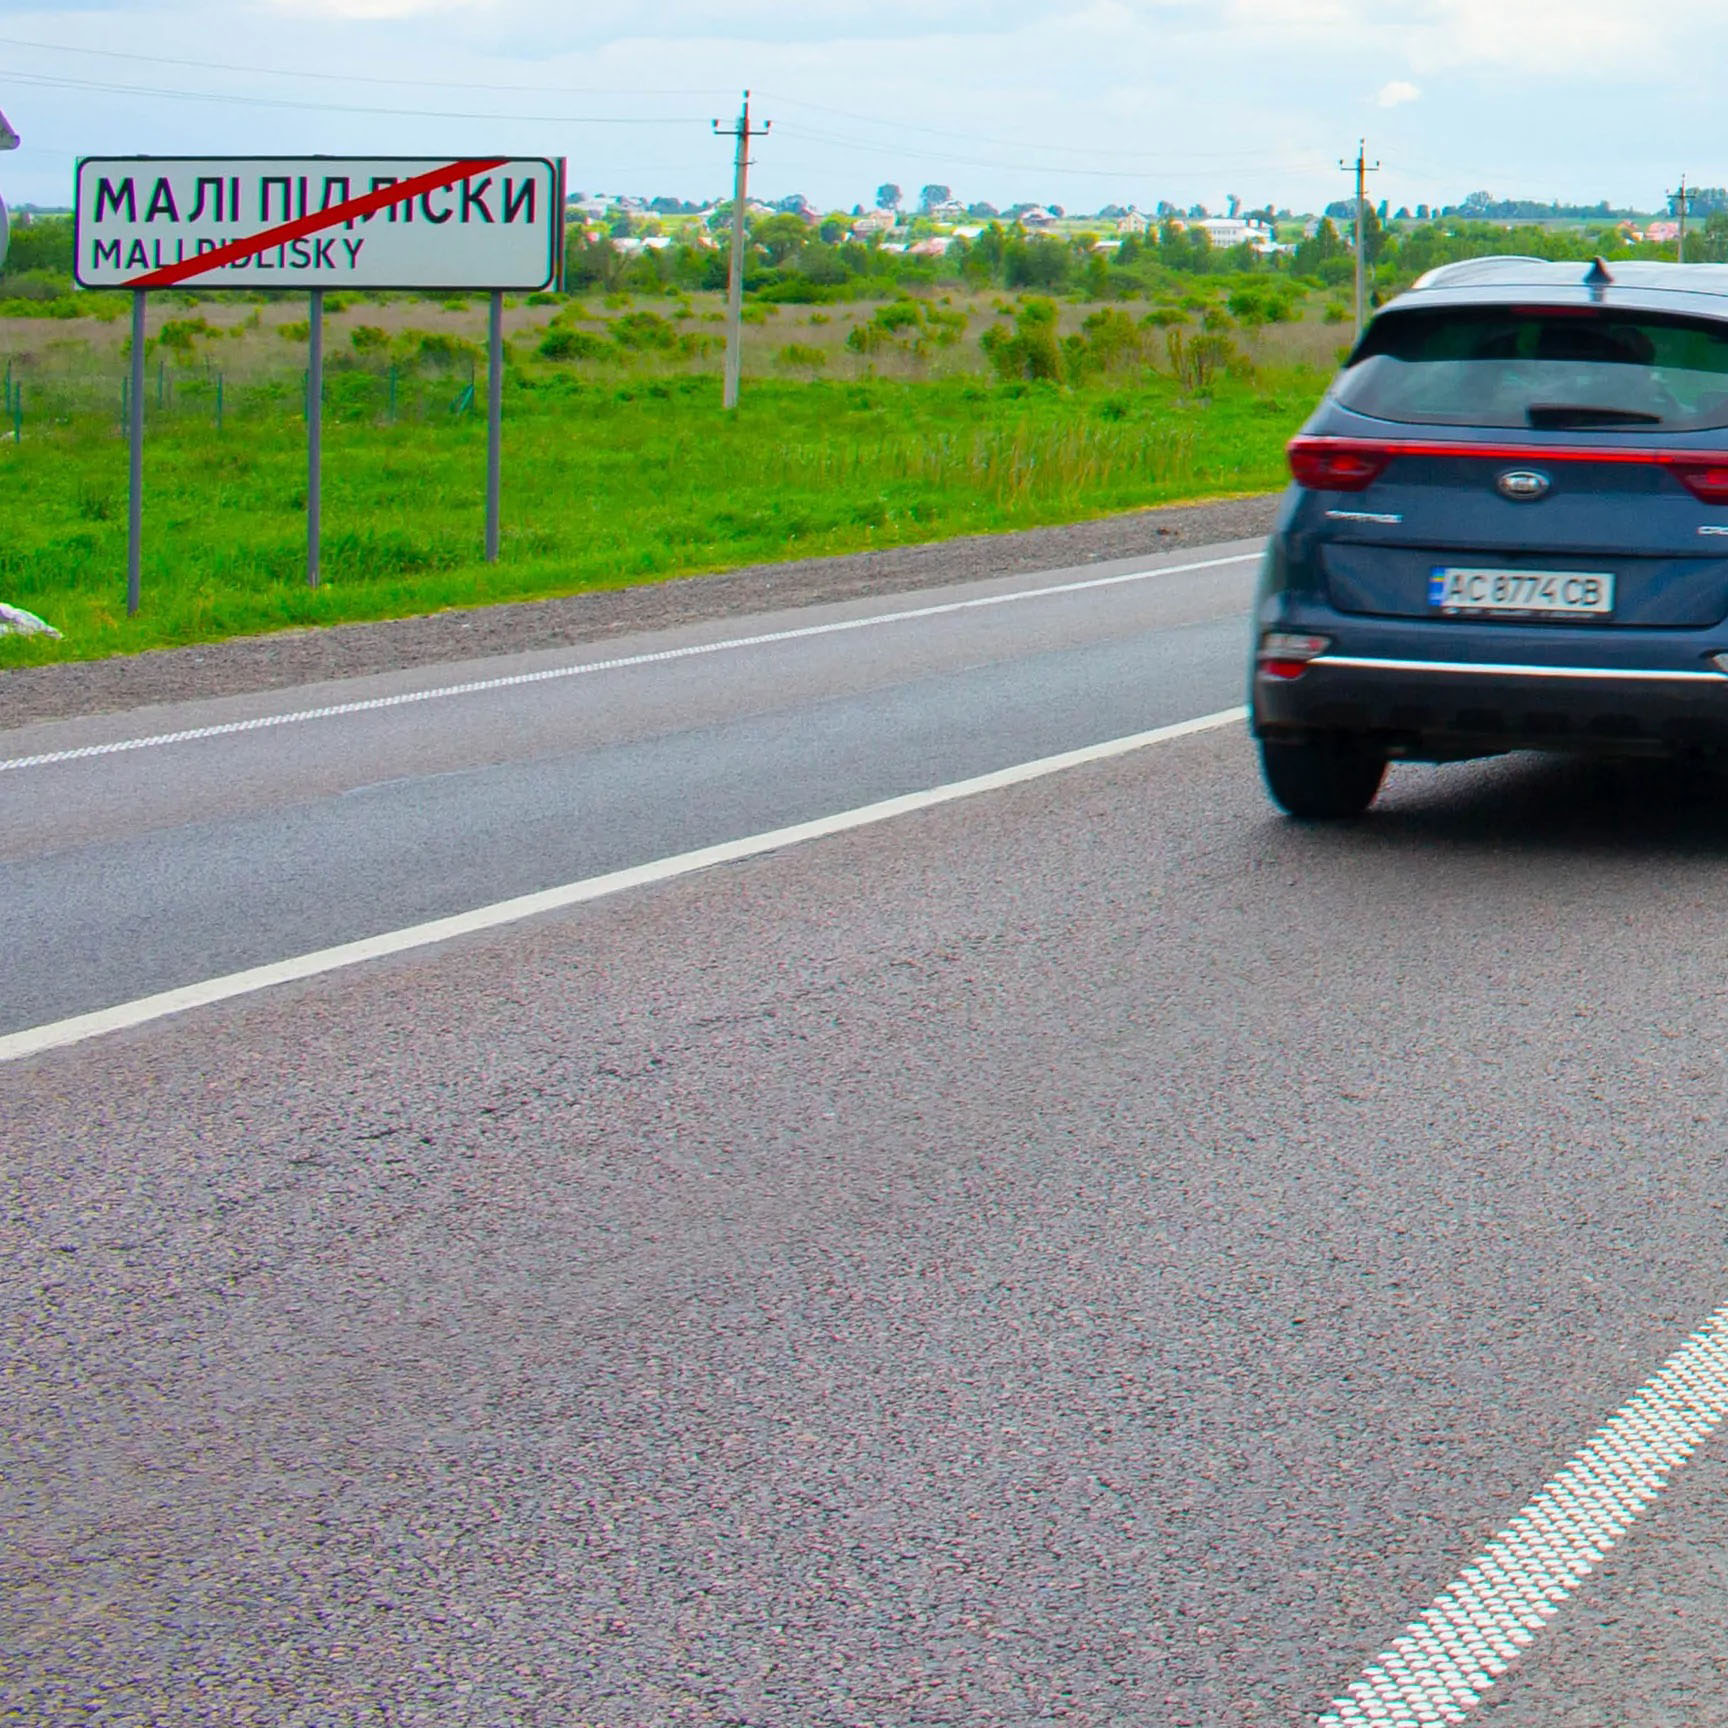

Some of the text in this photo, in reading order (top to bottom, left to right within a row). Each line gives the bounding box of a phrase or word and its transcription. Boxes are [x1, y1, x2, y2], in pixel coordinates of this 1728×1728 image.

[94, 176, 536, 230] МАЛІ ПІДЛІСКИ
[92, 238, 184, 270] MALI
[1447, 574, 1601, 606] AC 8774 CB
